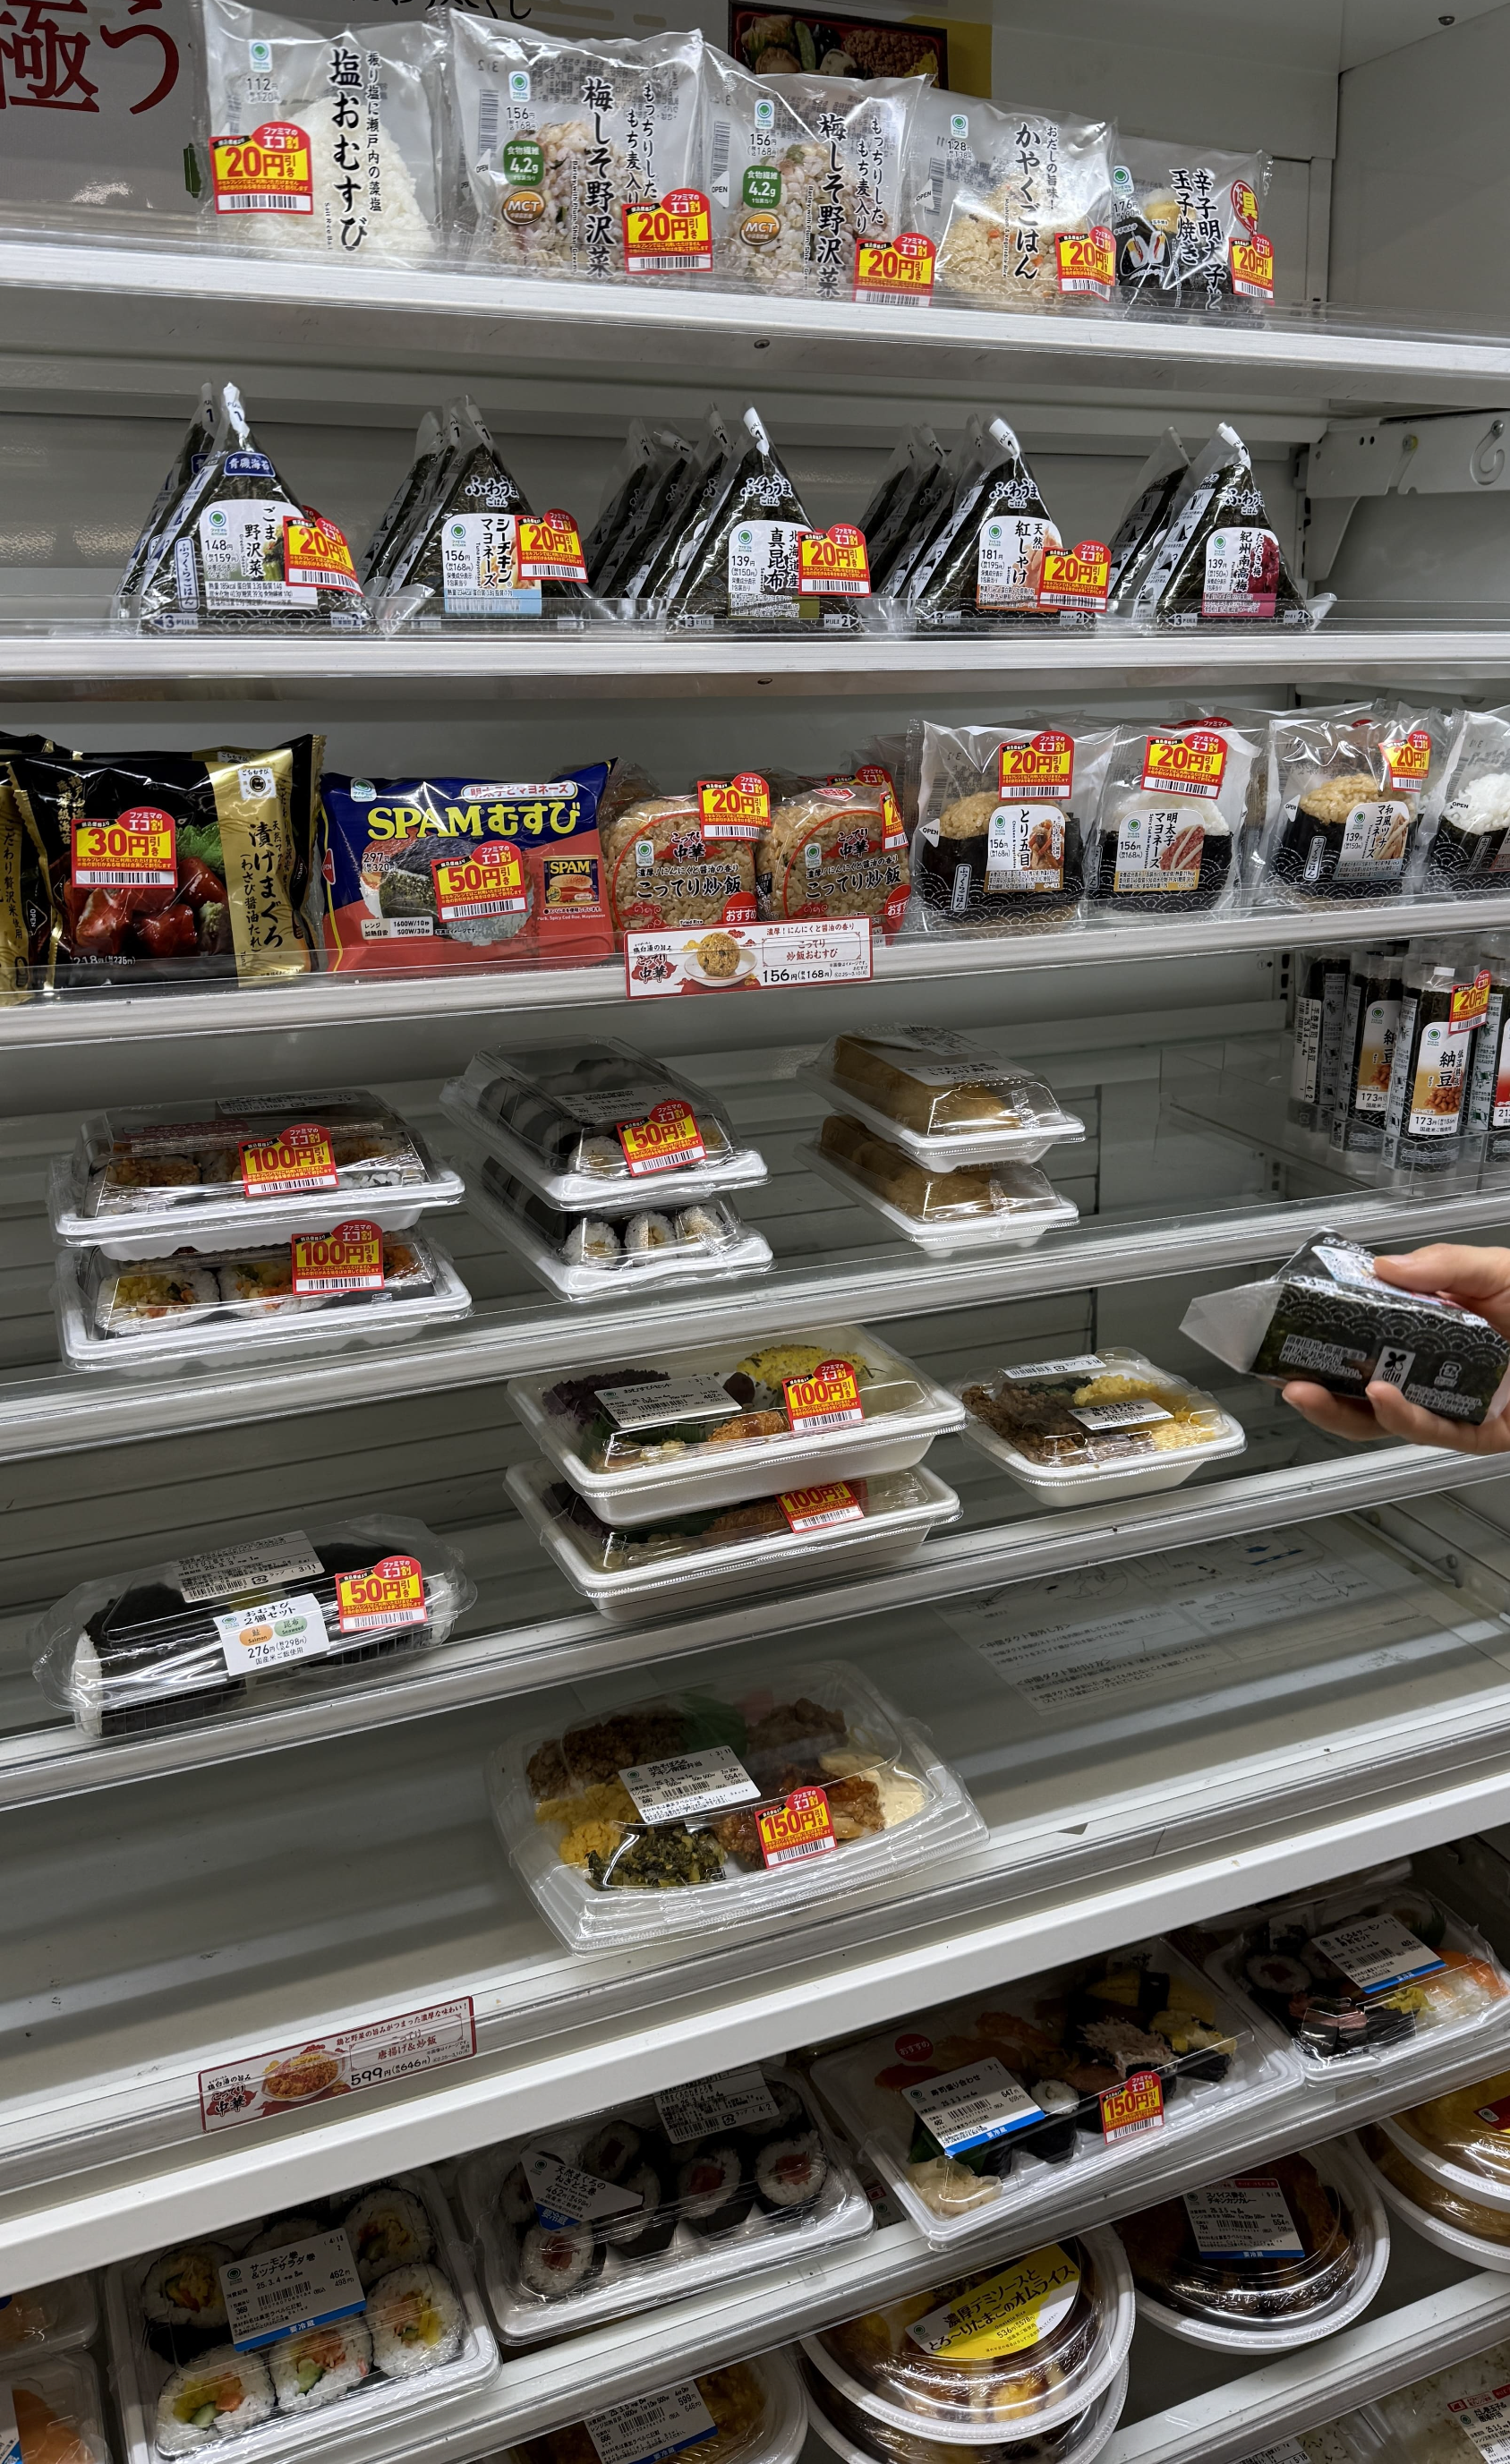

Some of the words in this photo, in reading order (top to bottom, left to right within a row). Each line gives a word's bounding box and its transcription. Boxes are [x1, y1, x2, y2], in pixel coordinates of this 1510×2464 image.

[506, 107, 535, 119] 156円
[263, 135, 299, 149] エコ割
[330, 48, 368, 251] 塩おむすび
[642, 82, 658, 199] もっちりした
[750, 133, 777, 146] 156円
[225, 146, 296, 177] 20円引き
[506, 146, 540, 156] 食物繊維
[509, 157, 539, 174] 4.2g
[747, 171, 779, 181] 食物繊維
[870, 116, 884, 224] もっちりした
[583, 77, 614, 277] 梅しそ野沢菜
[854, 140, 871, 234] もち麦入り
[711, 186, 729, 194] OPEN
[748, 181, 776, 197] 4.2g
[916, 190, 933, 202] OPEN
[508, 200, 541, 213] MCT
[670, 200, 701, 213] エコ割
[815, 114, 848, 297] 梅しそ野沢菜
[1014, 123, 1041, 279] かやくごはん
[637, 211, 698, 242] 20円引き
[1168, 167, 1199, 265] 玉子焼き
[745, 222, 776, 233] MCT
[867, 249, 924, 281] 20円引き
[740, 476, 793, 498] ふわうま
[990, 479, 1038, 500] ふわうま
[262, 507, 277, 541] ごま
[204, 539, 234, 551] 148円
[528, 525, 573, 553] 20円引き
[1033, 523, 1044, 550] 天然
[244, 523, 266, 576] 野沢菜
[444, 550, 471, 561] 156円
[481, 518, 496, 587] マヨネーズ
[496, 518, 513, 584] シーチキン
[765, 527, 788, 593] 真昆布
[810, 541, 858, 567] 20円引き
[981, 549, 1003, 560] 181円
[1012, 520, 1032, 585] 紅しゃけ
[731, 555, 755, 567] 139円
[1052, 557, 1100, 584] 20円引き
[1207, 558, 1228, 569] 139円
[1233, 530, 1253, 593] 紀州南高梅
[178, 541, 195, 606] ふっくらごはん
[1038, 741, 1066, 753] エコ割
[1191, 740, 1218, 754] エコ割
[1009, 750, 1062, 774] 20円引き
[1157, 746, 1214, 772] 20円引き
[469, 785, 569, 798] 明太子とマヨネーズ
[711, 788, 762, 815] 20円引き
[1452, 800, 1469, 810] OPEN
[128, 819, 164, 832] エコ割
[130, 812, 163, 821] ファミマの
[367, 804, 484, 840] SPAM
[488, 801, 581, 836] むすび
[1381, 804, 1395, 848] 和風ツナ
[922, 826, 940, 836] OPEN
[1019, 808, 1031, 868] とり五目
[1164, 811, 1179, 847] 明太子
[1345, 832, 1363, 842] 139円
[1365, 804, 1385, 858] マヨネーズ
[88, 828, 161, 857] 30円引き
[481, 845, 510, 854] ファミマの
[672, 840, 707, 860] 中華
[838, 840, 870, 858] 中華
[989, 838, 1009, 848] 156円
[1120, 840, 1141, 851] 156円
[1151, 812, 1166, 869] マヨネーズ
[363, 852, 391, 862] 297円
[482, 852, 512, 865] エコ割
[549, 860, 592, 874] SPAM
[249, 823, 284, 949] 漬けまぐろ
[448, 864, 511, 893] 50円引き
[636, 874, 742, 899] こってり炒飯
[806, 865, 902, 899] こってり炒飯
[726, 908, 757, 923] おすすめ
[636, 953, 669, 967] こってり
[786, 949, 839, 961] 炒飯おむすび
[638, 966, 668, 985] 中華
[762, 968, 798, 984] 156円
[1436, 1049, 1457, 1088] 納豆
[658, 1108, 686, 1123] エコ割
[1414, 1115, 1437, 1126] 173円
[288, 1127, 319, 1137] ファミマの
[288, 1134, 321, 1147] エコ割
[631, 1120, 687, 1150] 50円引き
[249, 1145, 327, 1172] 100円引き
[341, 1230, 373, 1243] エコ割
[342, 1223, 372, 1232] ファミマの
[301, 1241, 376, 1267] 100円引き
[790, 1380, 853, 1407] 100円引き
[382, 1560, 412, 1569] ファミマの
[382, 1565, 412, 1578] エコ割
[350, 1580, 412, 1604] 50円引き
[243, 1606, 298, 1626] 2個セット
[245, 1599, 291, 1617] おむすび
[248, 1634, 269, 1644] Salmon
[247, 1644, 277, 1659] 276円
[764, 1806, 825, 1840] 150円引き
[376, 2033, 439, 2061] 唐揚げ&炒飯
[898, 2039, 931, 2057] おすすめ
[350, 2066, 392, 2087] 599円
[929, 2074, 982, 2097] 寿司盛り合わせ
[1001, 2088, 1020, 2099] 647円
[215, 2094, 247, 2118] 中華
[1105, 2091, 1157, 2120] 150円引き
[555, 2164, 607, 2191] 天然まぐろの
[250, 2250, 300, 2272] サーモン巻
[329, 2268, 352, 2281] 462円
[942, 2268, 1040, 2330] 濃厚デミソースと
